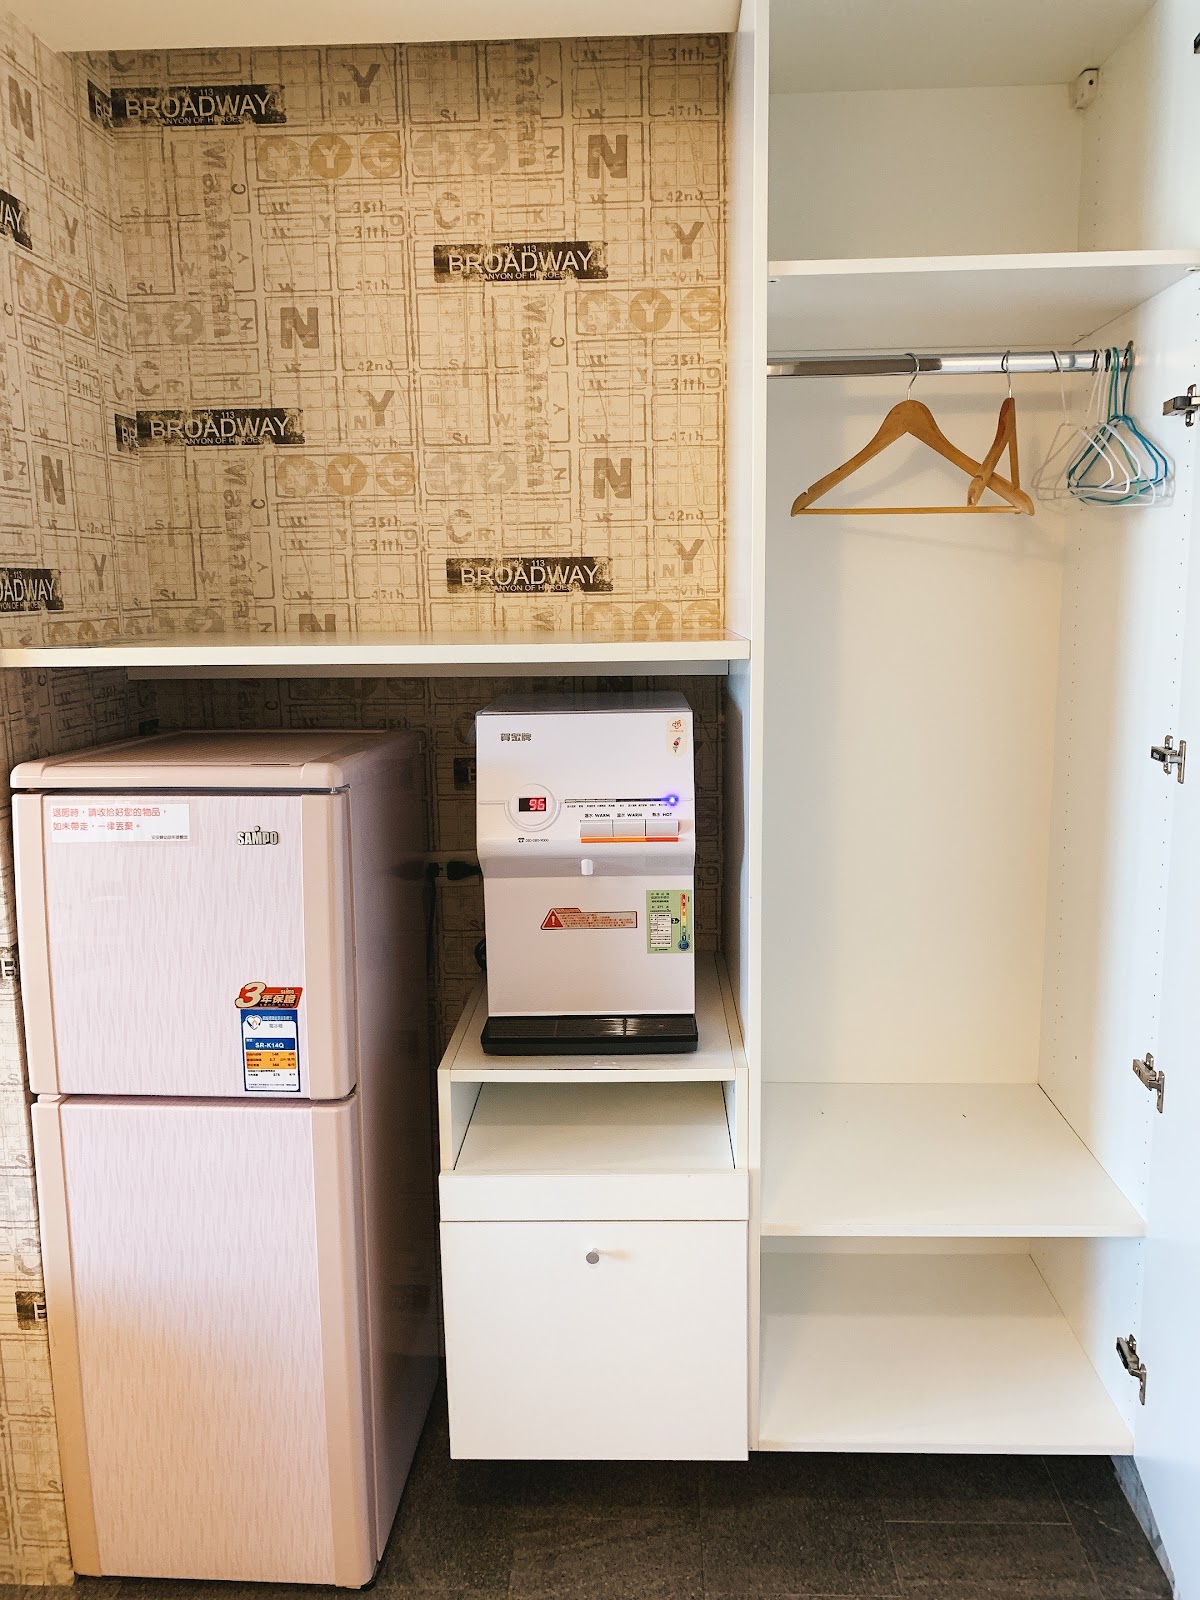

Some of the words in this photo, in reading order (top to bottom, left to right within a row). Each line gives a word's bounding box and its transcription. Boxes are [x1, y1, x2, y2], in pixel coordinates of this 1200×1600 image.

[345, 64, 381, 104] Y
[8, 75, 34, 141] N
[125, 94, 270, 118] BROADWAY
[587, 134, 628, 179] N
[231, 183, 246, 195] C
[669, 222, 704, 260] Y
[448, 250, 593, 274] BROADWAY
[280, 307, 319, 349] N
[551, 337, 565, 347] C
[671, 353, 704, 366] 35th
[366, 390, 395, 427] Y
[150, 417, 290, 439] BROADWAY
[41, 455, 66, 505] N
[593, 458, 631, 499] N
[252, 499, 265, 509] C
[673, 539, 705, 574] Y
[88, 554, 107, 591] Y
[461, 565, 599, 585] BROADWAY
[663, 564, 675, 577] N
[529, 799, 545, 811] 96
[237, 826, 278, 845] SAMPO
